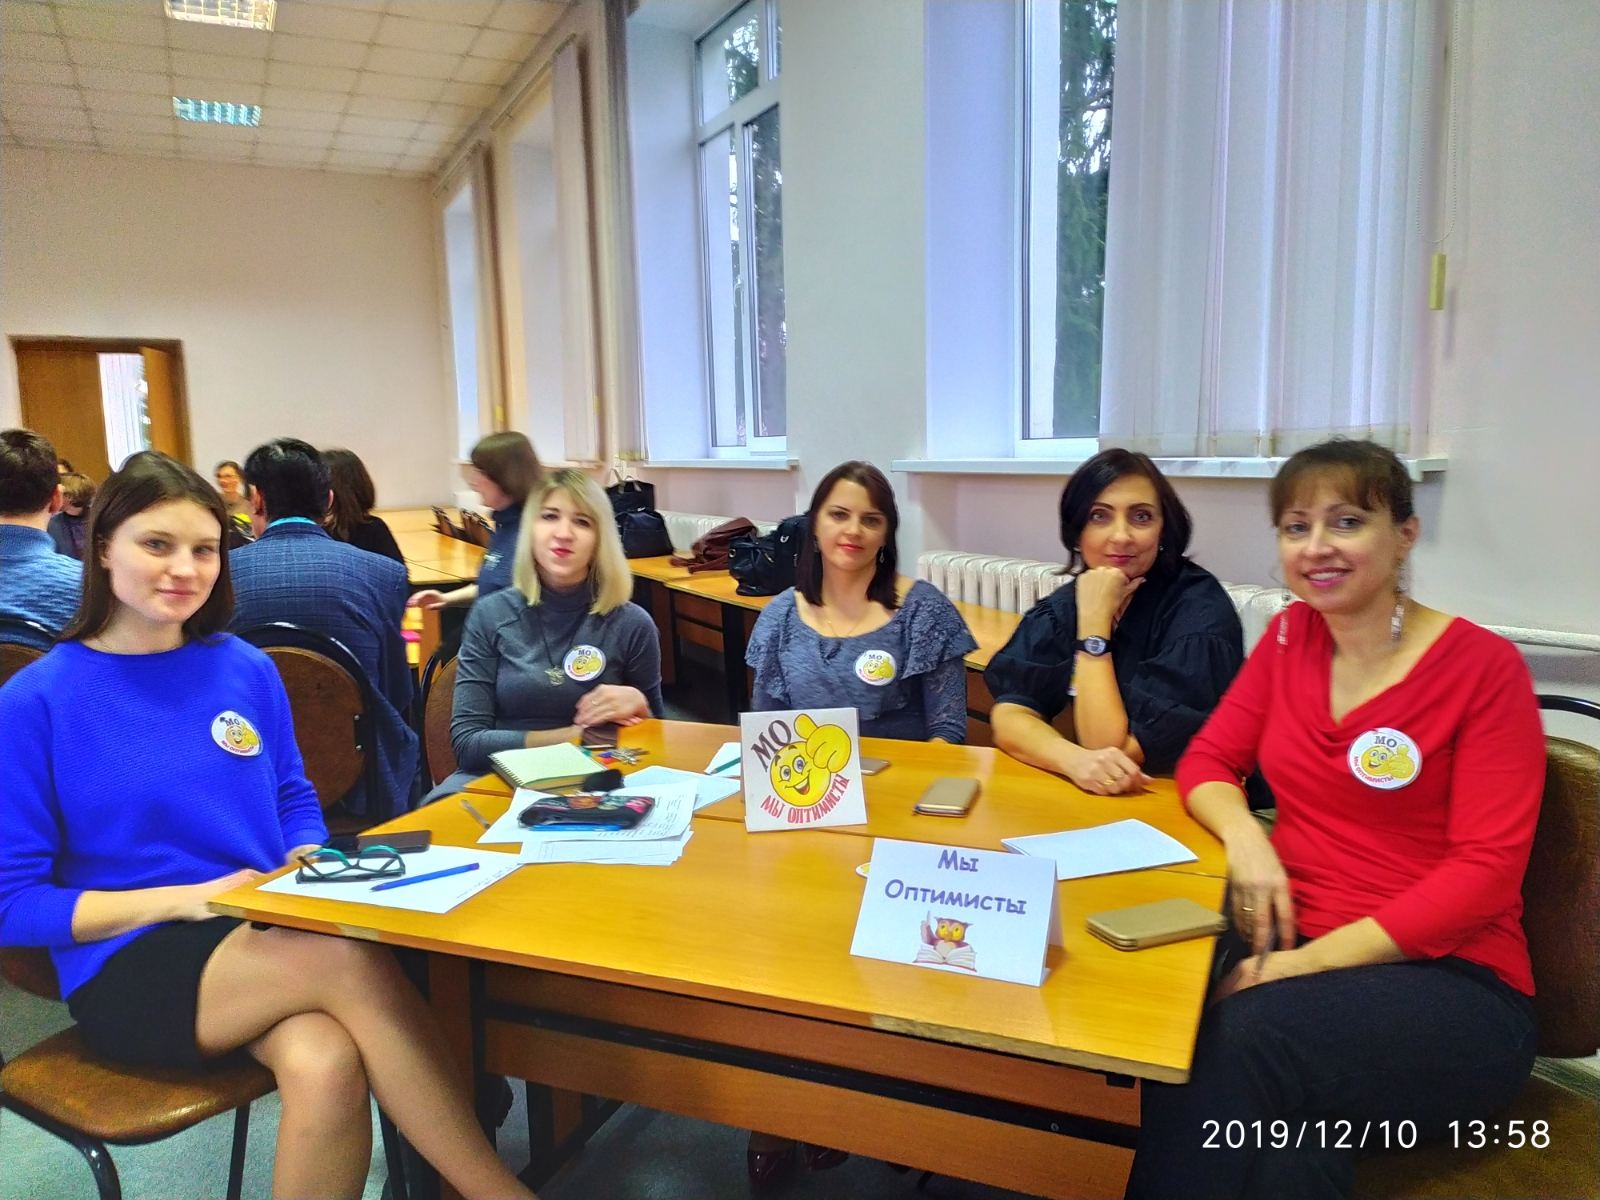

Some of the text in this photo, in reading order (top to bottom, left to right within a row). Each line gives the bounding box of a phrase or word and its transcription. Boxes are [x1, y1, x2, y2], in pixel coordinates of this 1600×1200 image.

[751, 719, 792, 773] МО
[1374, 735, 1397, 748] МО
[760, 773, 850, 824] МЫ ОПТИМИСТЫ
[937, 849, 979, 872] Мы
[884, 879, 1027, 915] Оптимисты
